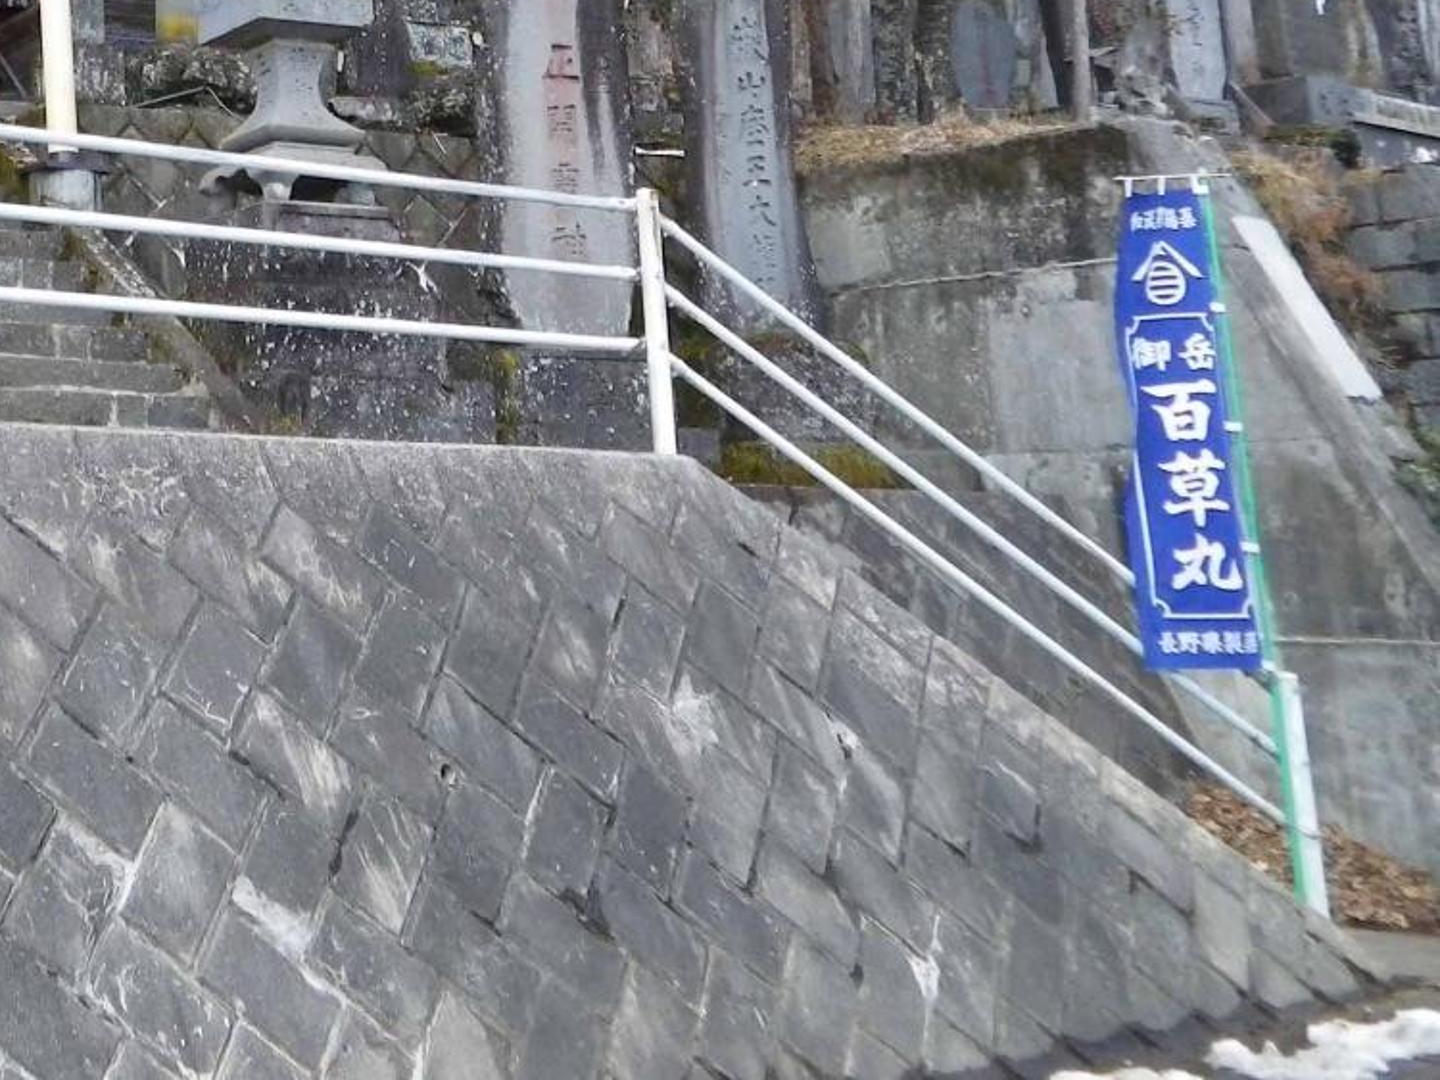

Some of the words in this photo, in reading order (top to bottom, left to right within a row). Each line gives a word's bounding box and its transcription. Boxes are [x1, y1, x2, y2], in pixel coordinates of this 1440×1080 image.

[1132, 333, 1216, 372] 御岳
[1141, 379, 1243, 591] 百草丸
